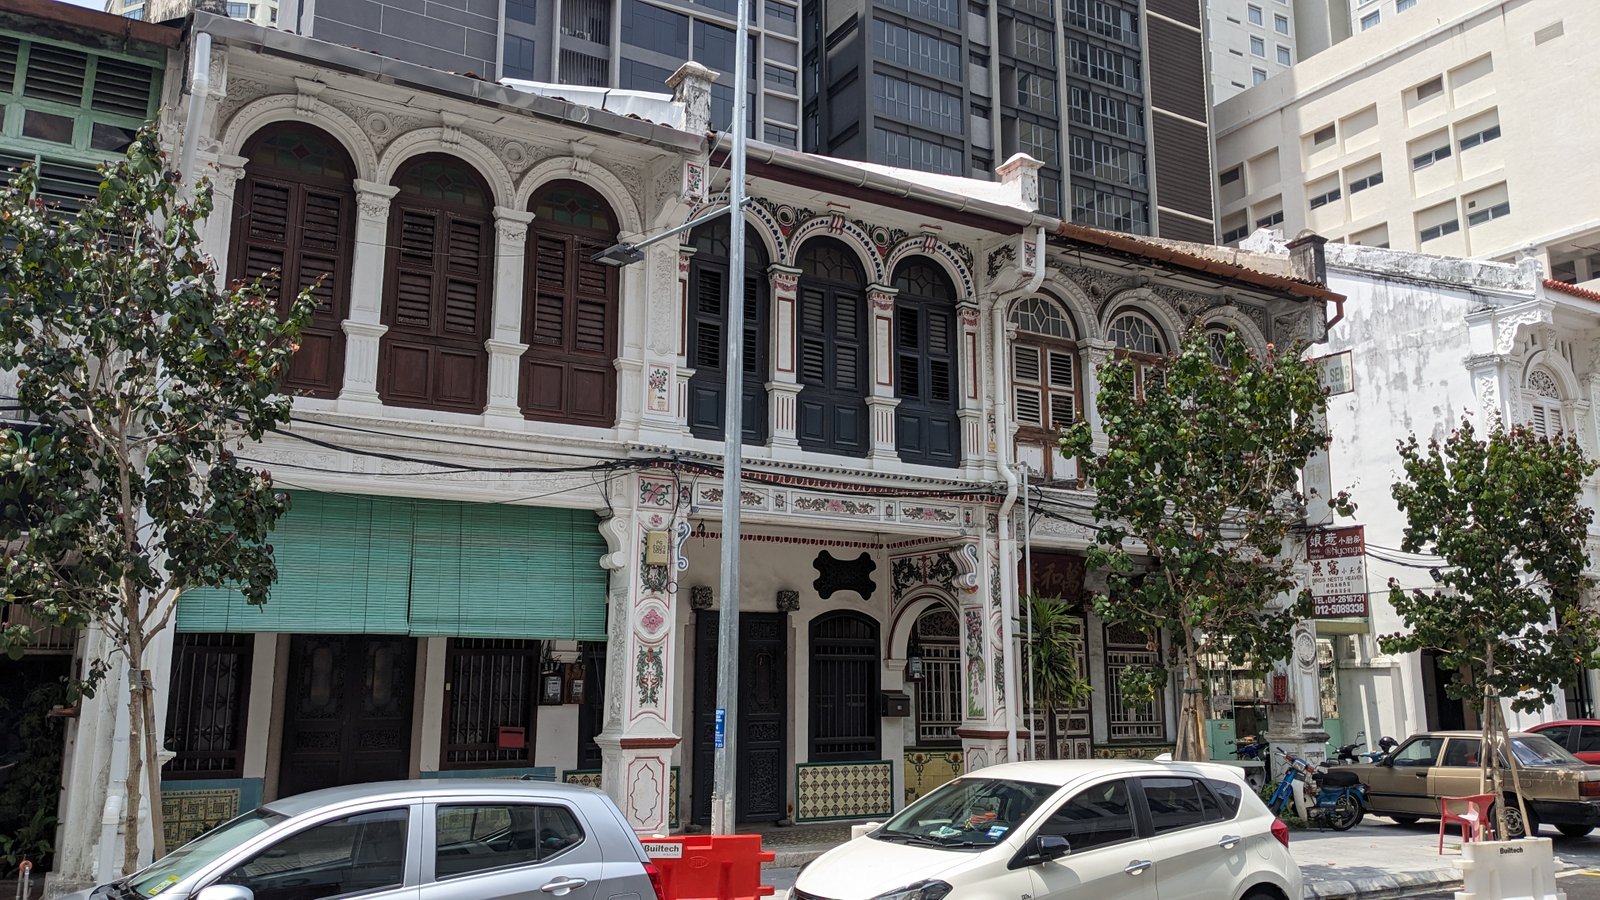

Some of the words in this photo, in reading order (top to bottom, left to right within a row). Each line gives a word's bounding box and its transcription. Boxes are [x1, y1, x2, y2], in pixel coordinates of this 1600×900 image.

[1330, 366, 1350, 383] SENG
[1314, 603, 1365, 614] 012-5089338
[644, 844, 680, 853] Builtech
[1500, 846, 1523, 855] Builtech
